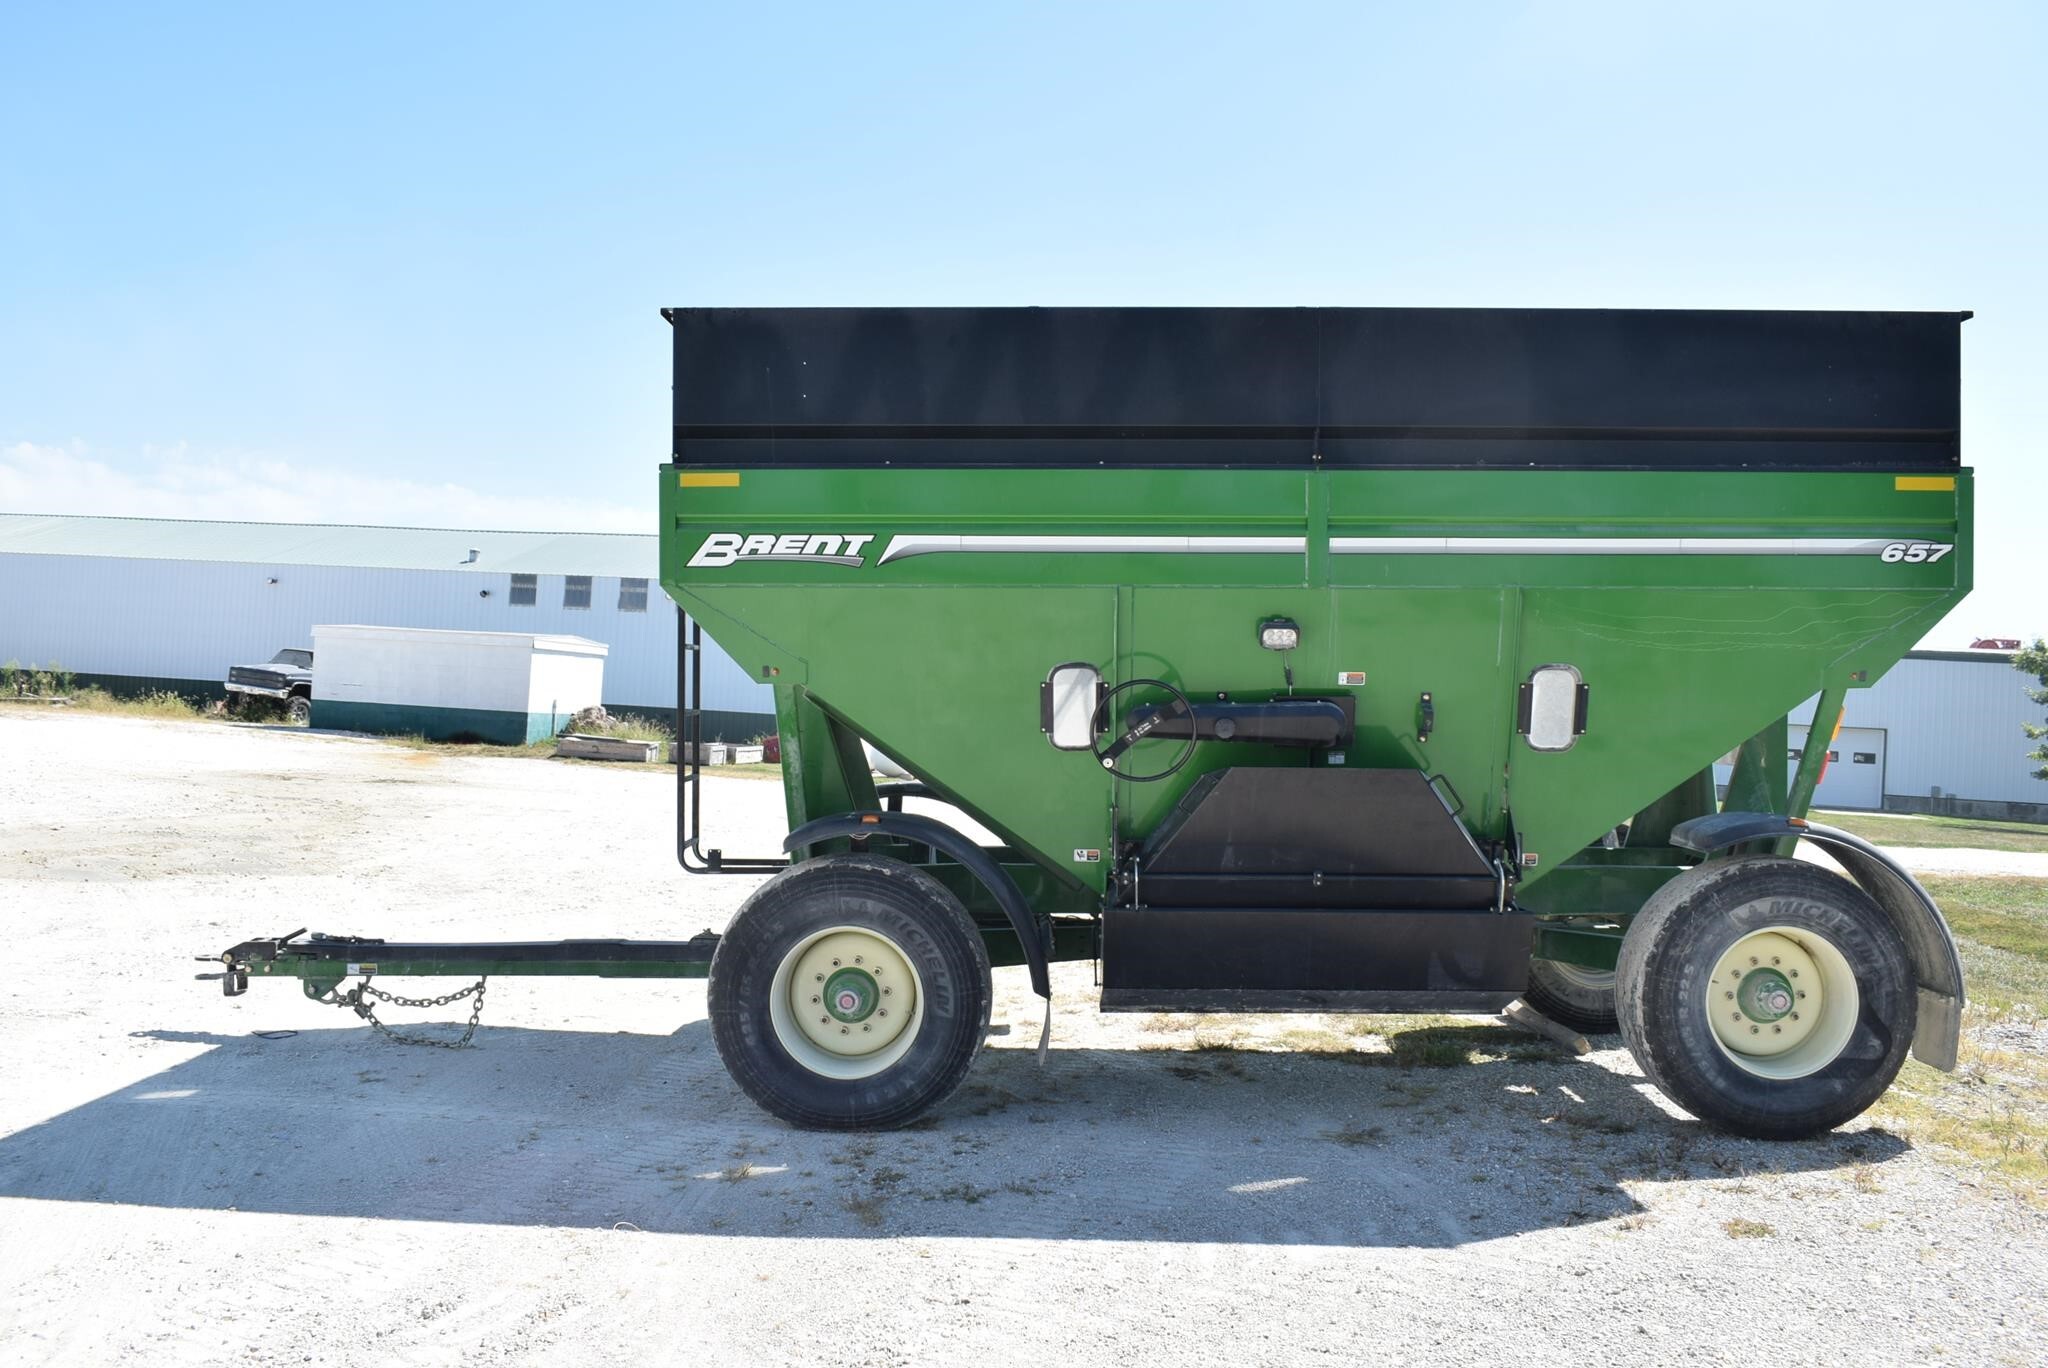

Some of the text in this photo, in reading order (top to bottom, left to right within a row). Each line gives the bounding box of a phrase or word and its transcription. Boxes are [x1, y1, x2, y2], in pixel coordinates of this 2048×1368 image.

[686, 533, 875, 566] BRENT
[1881, 543, 1954, 563] 657
[876, 907, 951, 1016] MICHELIN
[1768, 901, 1882, 972] MICHELIN
